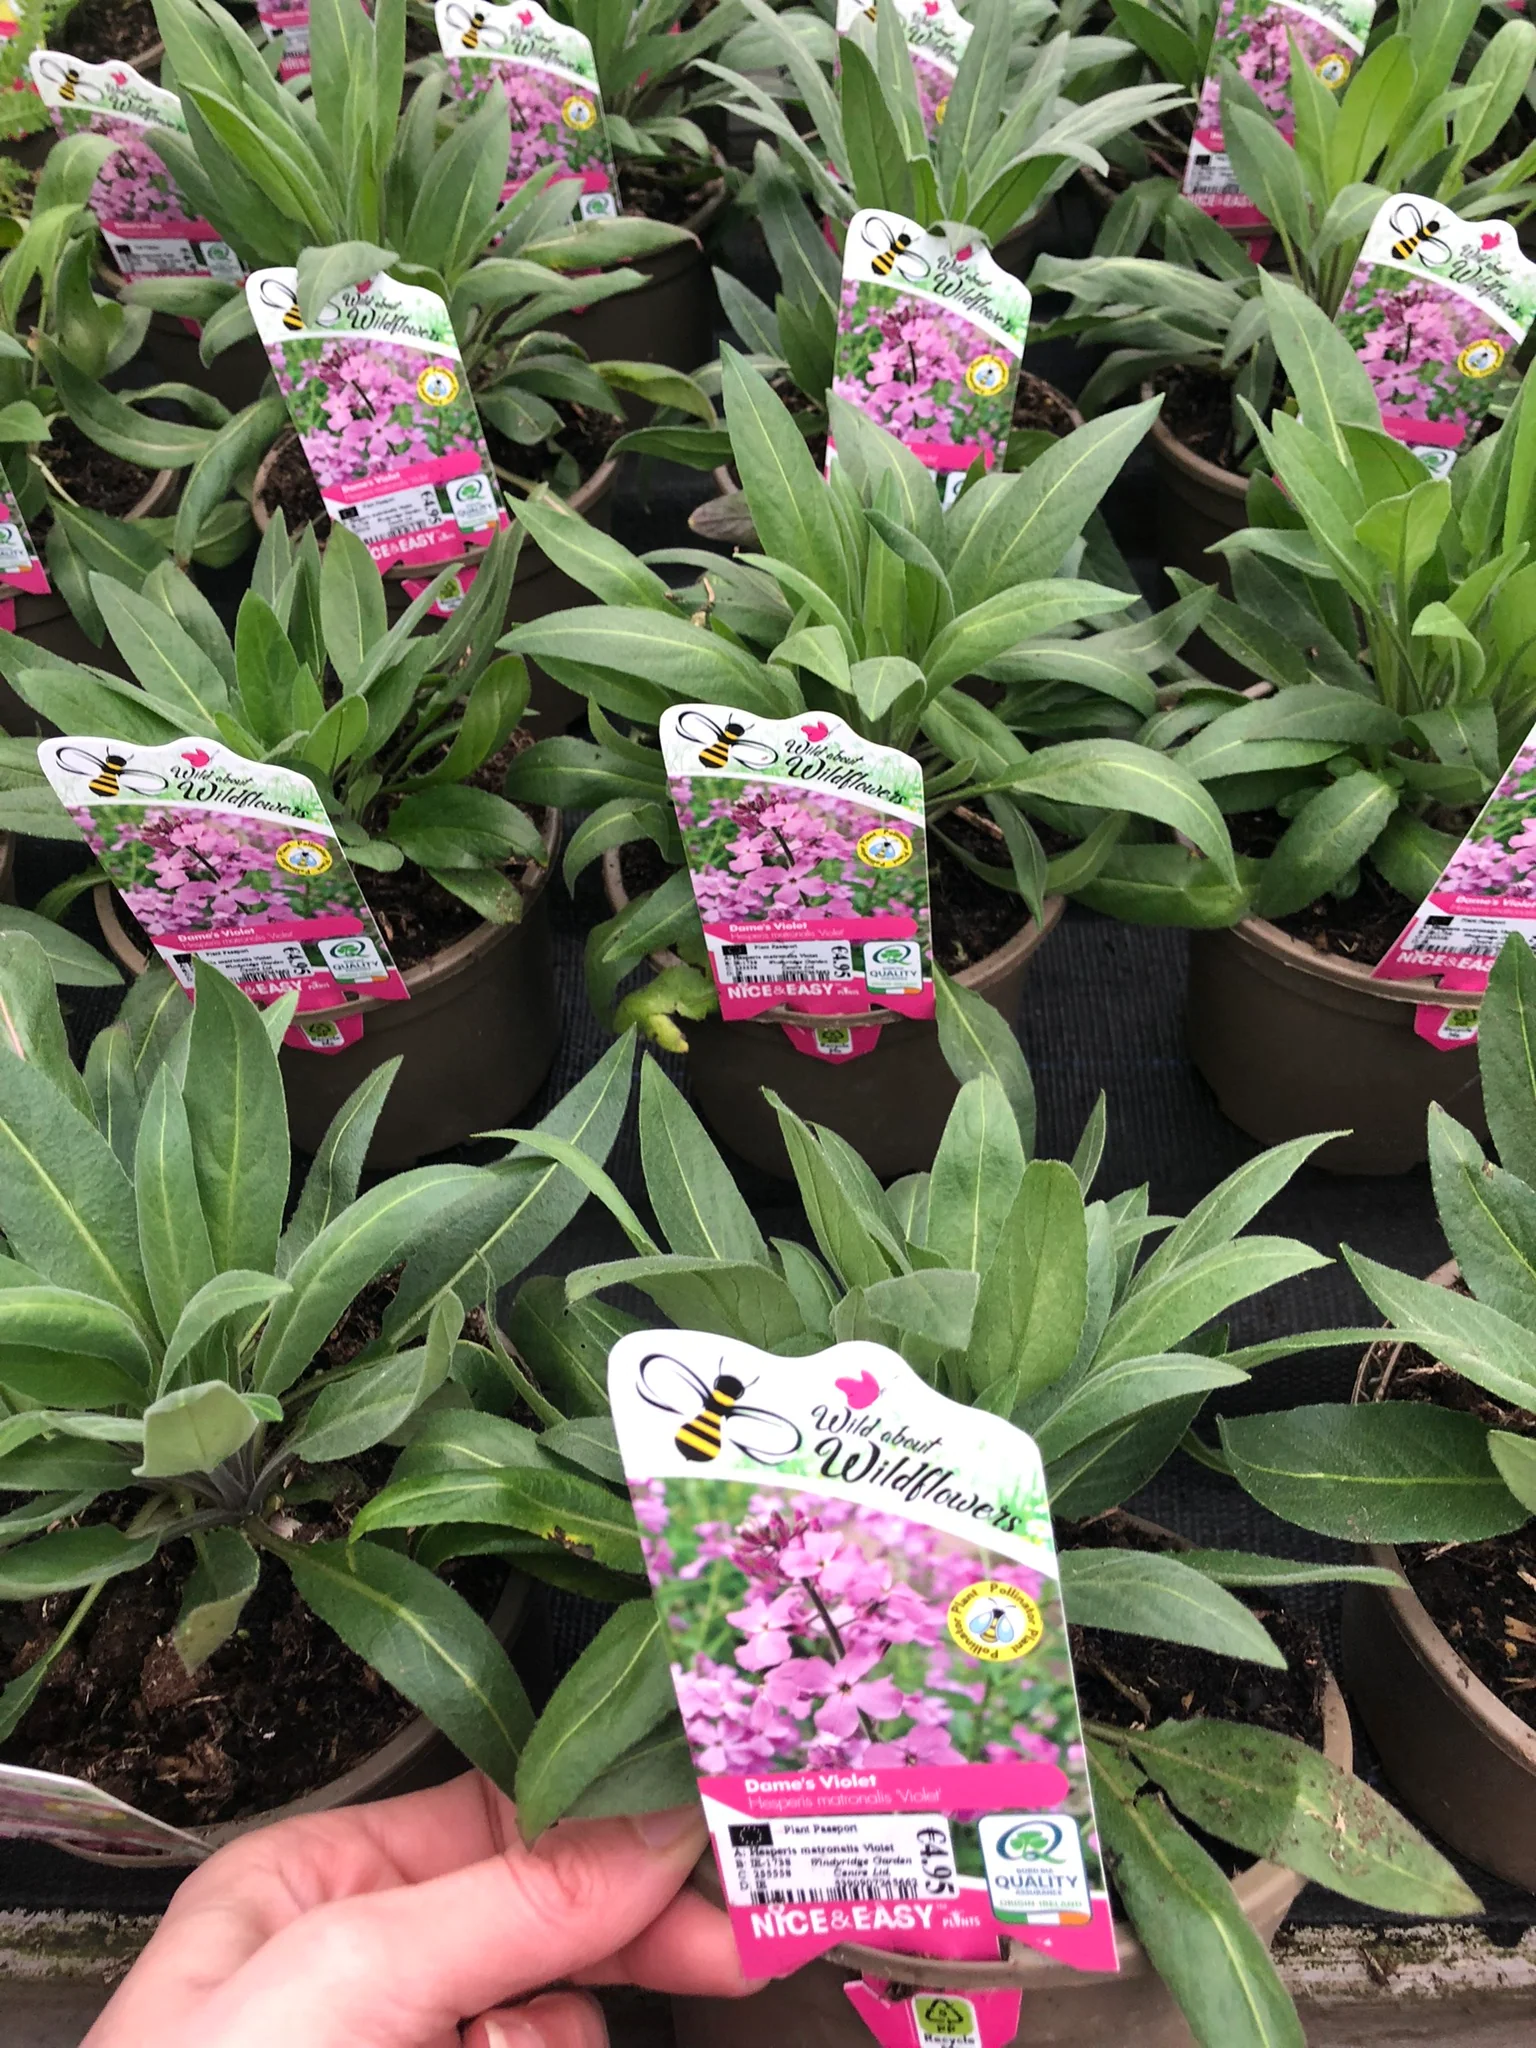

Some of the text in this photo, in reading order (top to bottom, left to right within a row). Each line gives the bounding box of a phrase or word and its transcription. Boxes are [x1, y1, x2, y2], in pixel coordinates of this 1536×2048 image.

[347, 307, 439, 341] Wildflowers
[784, 738, 864, 766] Wild about
[170, 764, 254, 786] Wild about
[785, 756, 909, 805] Wildflowers
[177, 780, 310, 819] Wildflowers
[178, 927, 256, 943] Dame's Violet
[729, 922, 808, 933] Dame's Violet
[332, 961, 380, 971] QUALITY
[831, 945, 852, 979] €4.95
[869, 970, 917, 978] QUALITY
[811, 1404, 943, 1454] Wild about
[814, 1436, 1022, 1532] Wildflowers
[951, 1589, 999, 1659] Pollinator Plant
[990, 1583, 1040, 1653] Pollinator Plant
[744, 1774, 877, 1794] Dame's Violet
[749, 1796, 813, 1812] Hesperis
[817, 1789, 892, 1808] matronalis
[784, 1824, 858, 1836] Plant Passport
[750, 1846, 797, 1858] Hesperis
[800, 1844, 859, 1855] matronalis
[863, 1843, 895, 1853] Violet
[872, 1856, 912, 1866] Garden
[916, 1826, 955, 1895] €4.95
[995, 1875, 1078, 1890] QUALITY
